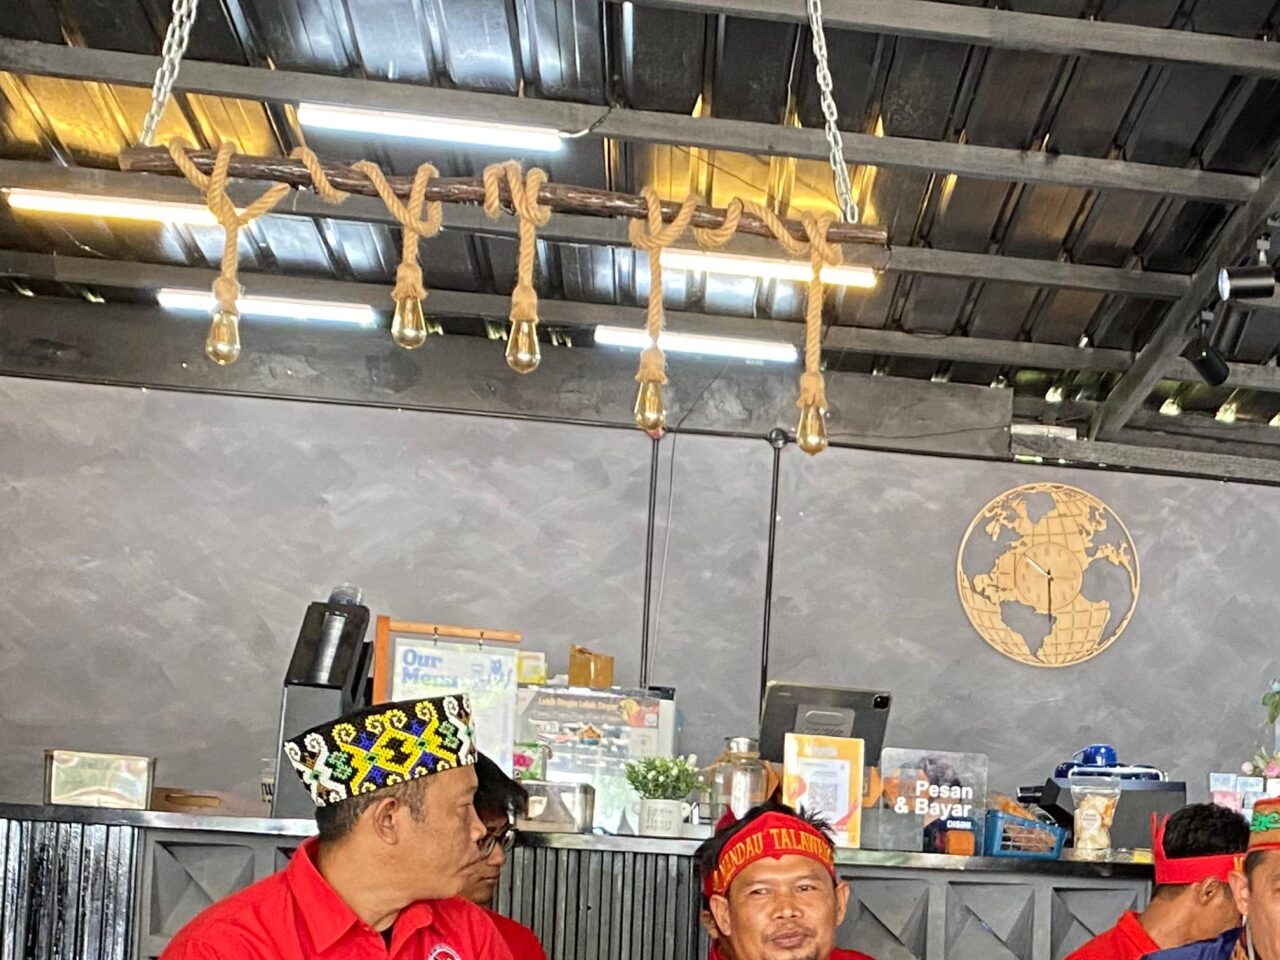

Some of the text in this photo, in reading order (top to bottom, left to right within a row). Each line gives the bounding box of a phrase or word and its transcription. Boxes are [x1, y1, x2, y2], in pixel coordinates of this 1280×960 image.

[403, 649, 443, 668] Our
[916, 781, 973, 799] Pesan
[894, 796, 972, 820] & Bayar
